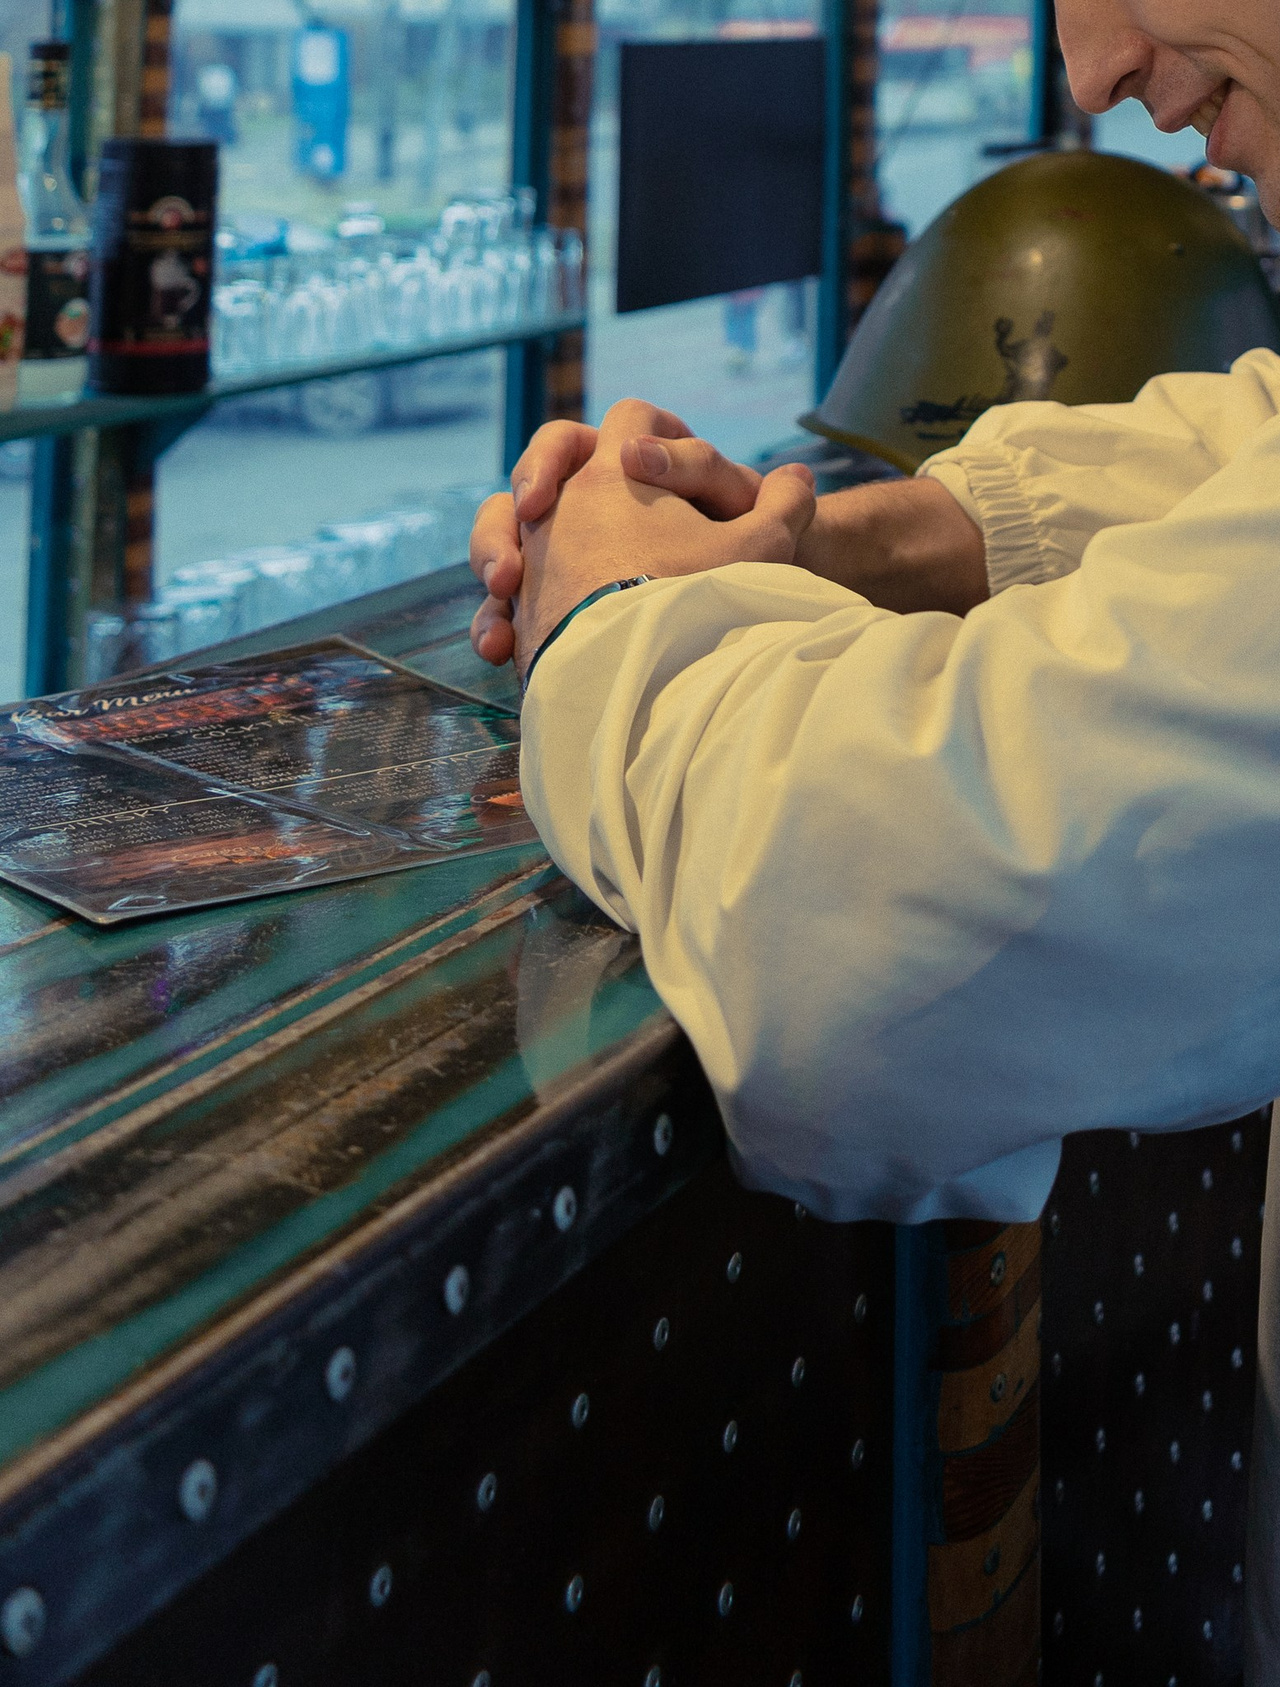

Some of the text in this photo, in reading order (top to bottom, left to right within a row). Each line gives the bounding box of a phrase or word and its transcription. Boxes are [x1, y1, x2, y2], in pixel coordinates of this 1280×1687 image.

[11, 688, 197, 723] Bar Menu
[48, 806, 169, 831] WHISKY
